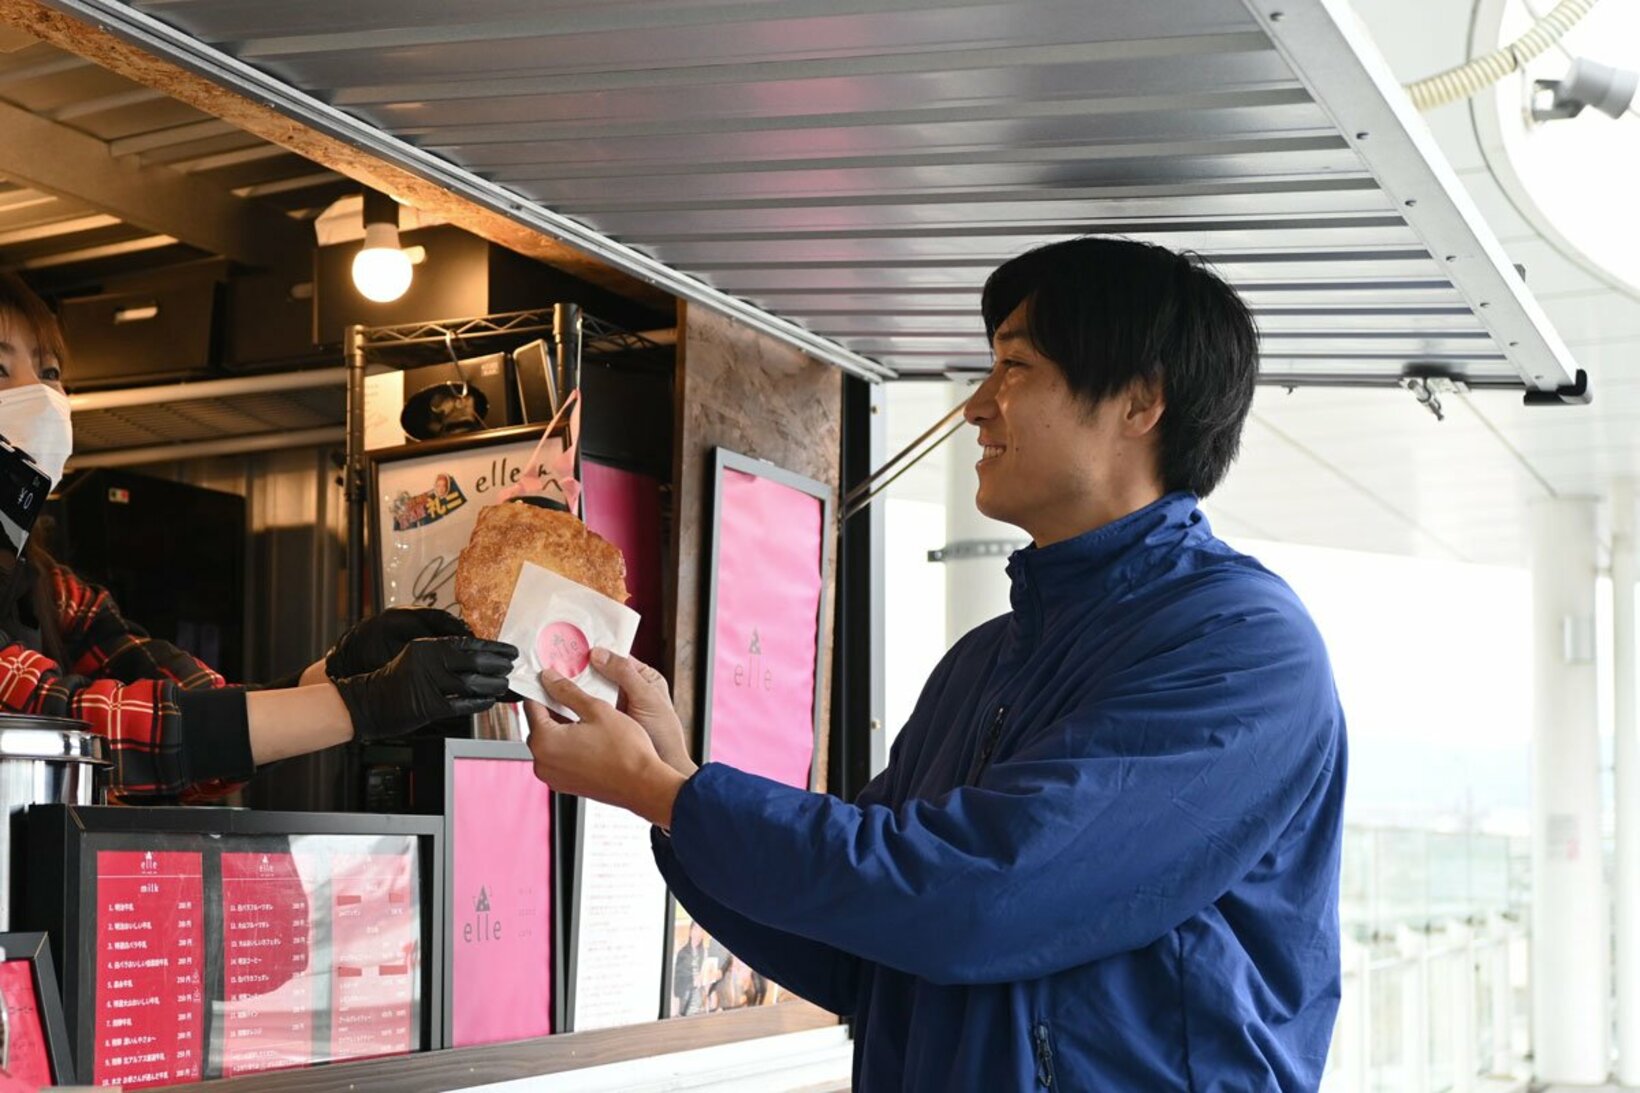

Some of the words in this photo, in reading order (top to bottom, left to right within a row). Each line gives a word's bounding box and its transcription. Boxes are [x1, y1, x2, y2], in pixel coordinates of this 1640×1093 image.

[475, 457, 521, 493] elle
[734, 655, 772, 692] elle
[140, 859, 158, 870] elle
[140, 882, 160, 893] milk
[463, 913, 502, 943] elle
